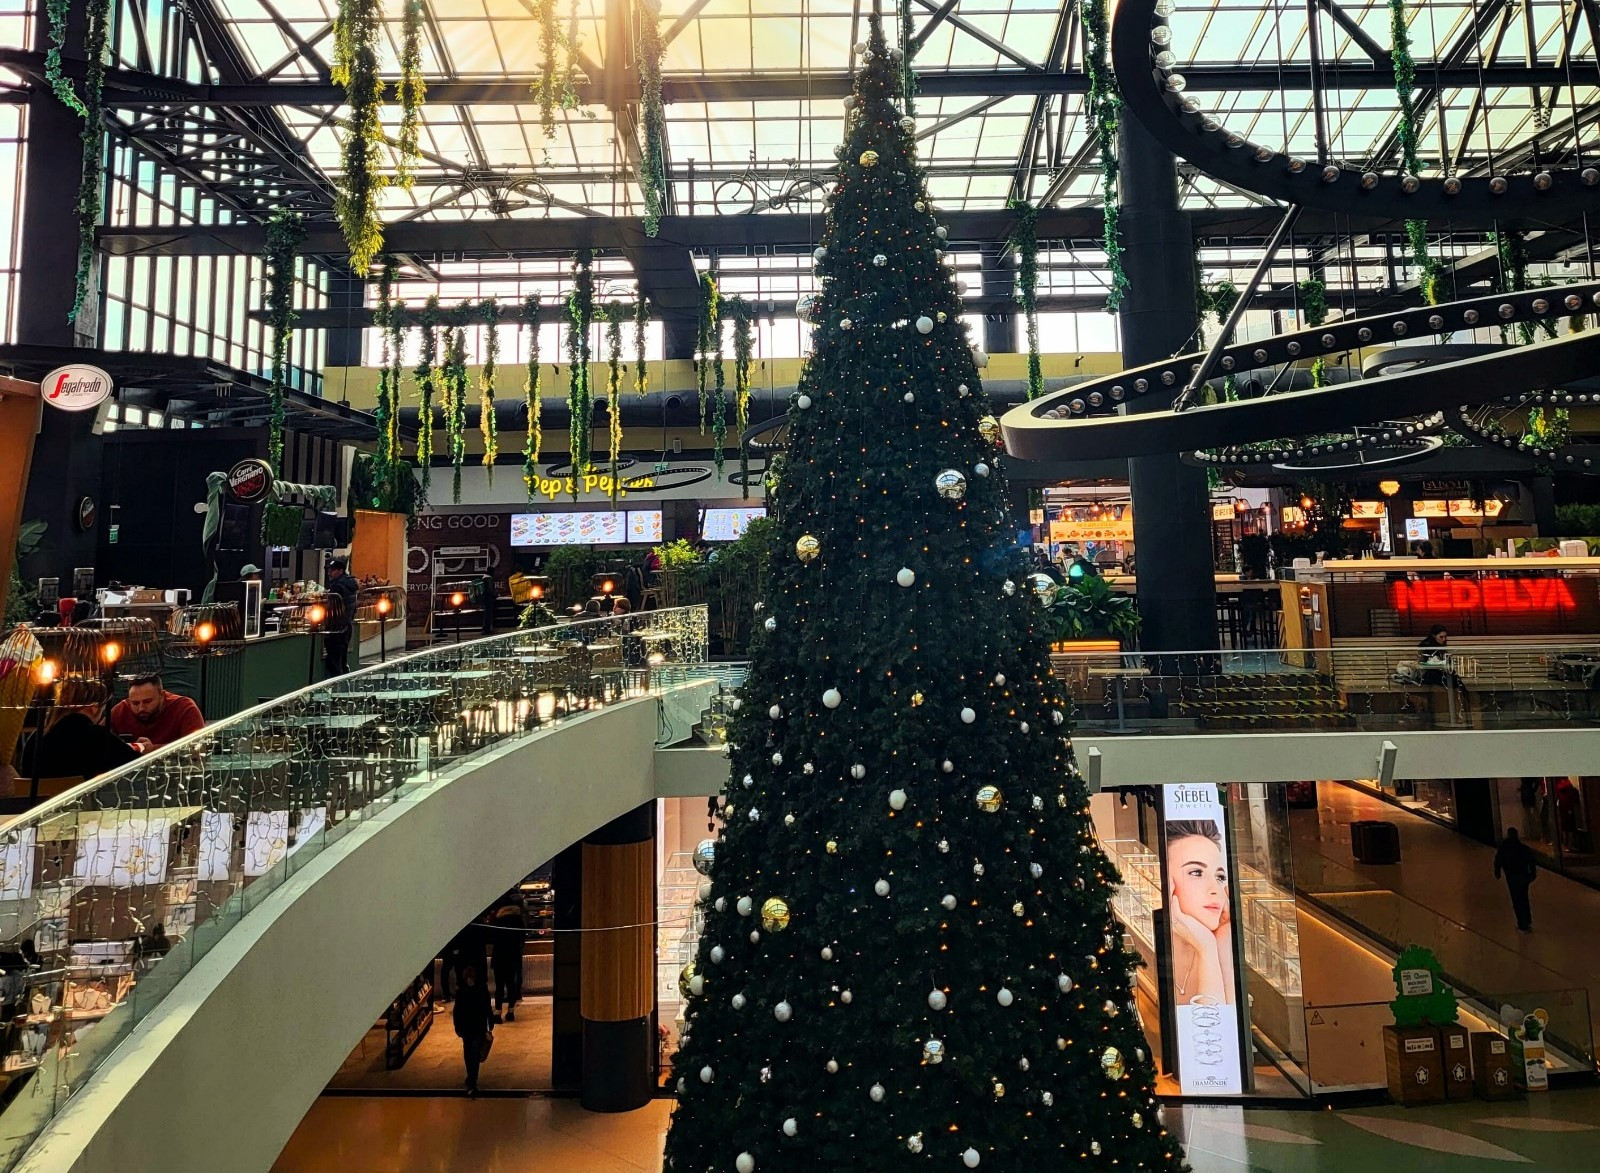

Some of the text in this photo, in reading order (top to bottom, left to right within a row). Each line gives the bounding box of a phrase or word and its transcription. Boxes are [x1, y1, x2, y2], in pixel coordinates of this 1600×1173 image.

[49, 374, 102, 398] Segafredo
[448, 515, 500, 528] GOOD
[1395, 578, 1577, 609] NEDELYA
[1174, 790, 1213, 803] SIEBEL
